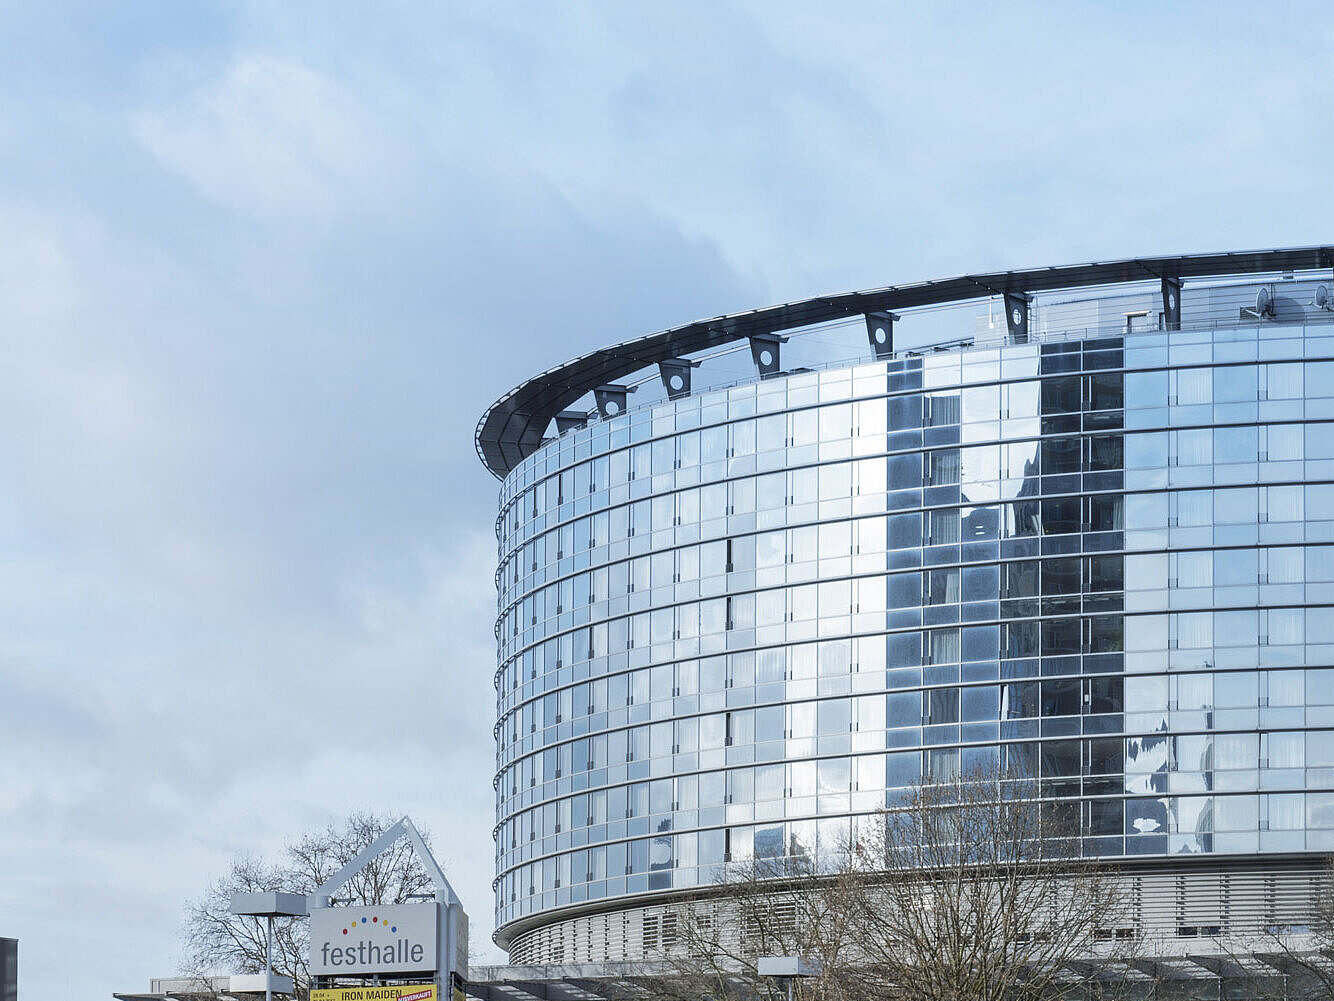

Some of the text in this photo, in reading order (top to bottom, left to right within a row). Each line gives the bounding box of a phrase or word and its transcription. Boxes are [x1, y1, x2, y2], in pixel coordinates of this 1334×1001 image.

[321, 939, 424, 966] festhalle
[341, 990, 402, 1001] IRON MAIDEN
